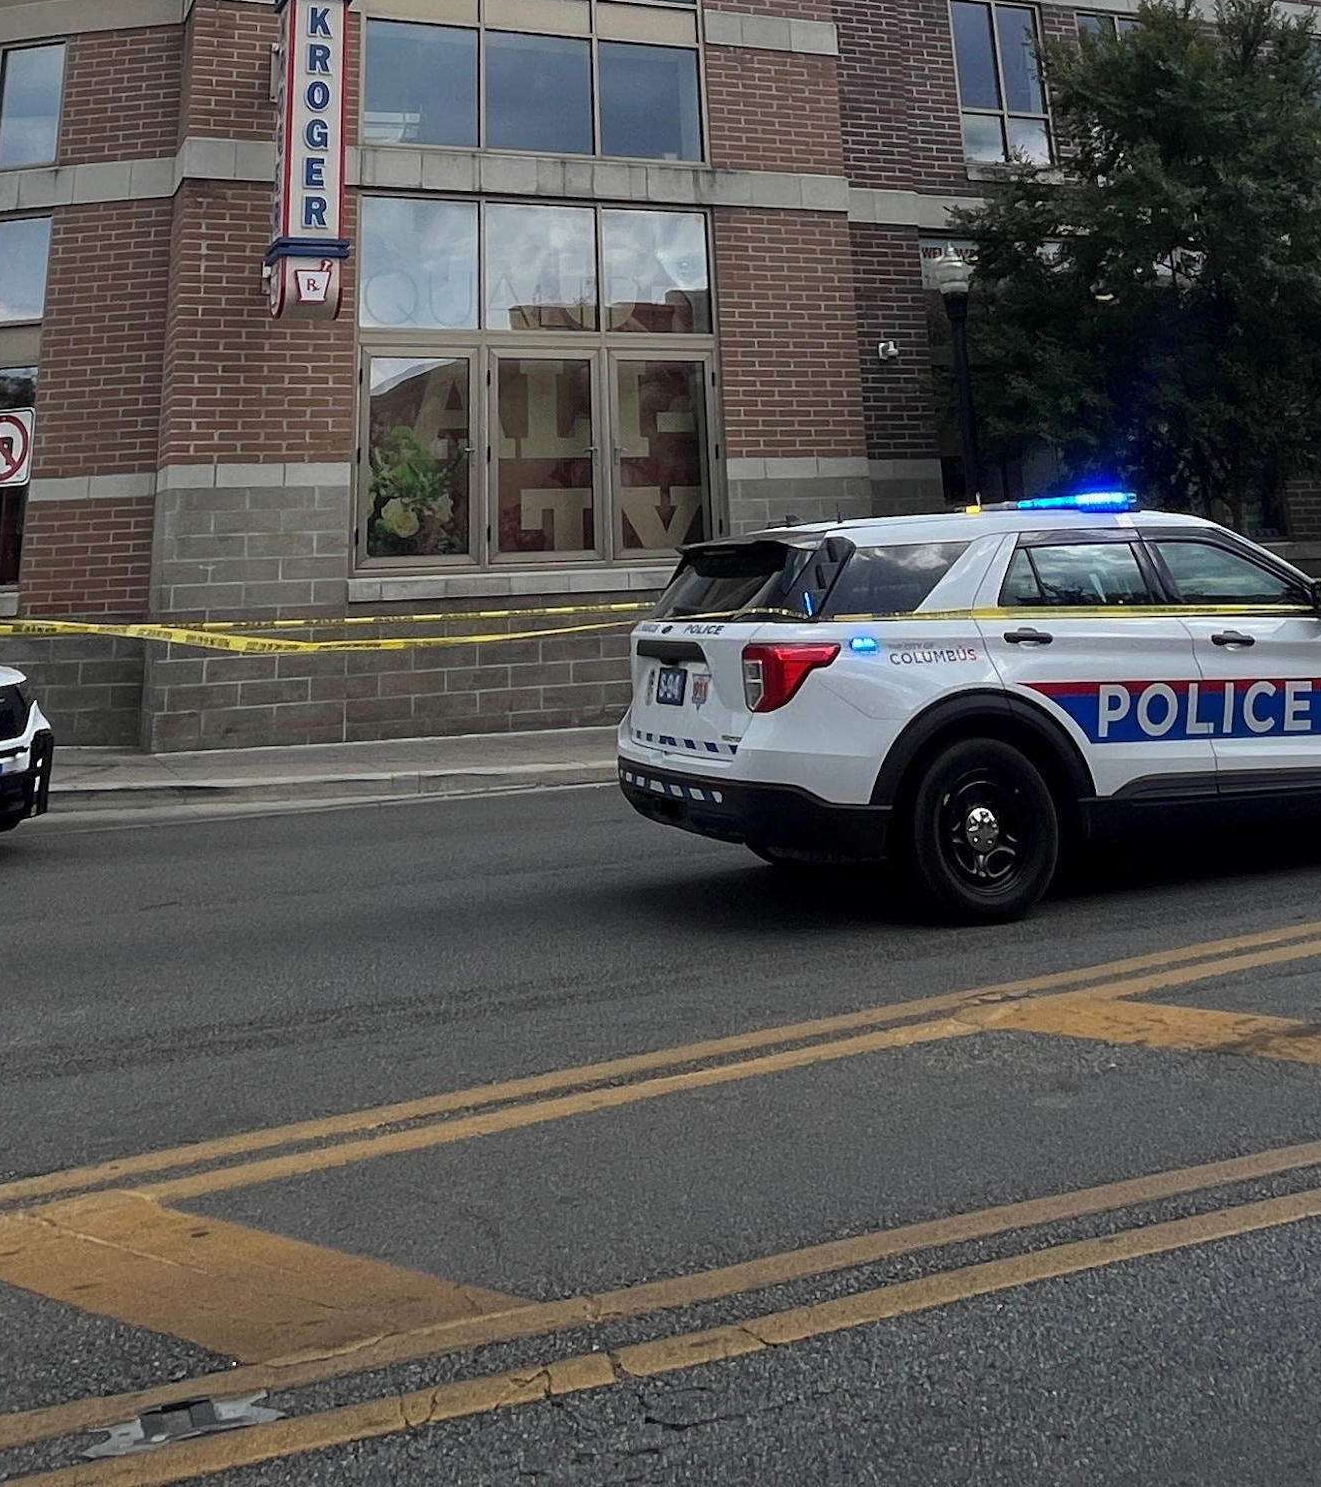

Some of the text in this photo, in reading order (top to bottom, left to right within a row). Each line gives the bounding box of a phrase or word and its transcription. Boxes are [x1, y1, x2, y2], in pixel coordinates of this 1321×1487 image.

[303, 5, 333, 229] KROGER
[684, 624, 725, 635] POLICE
[889, 647, 977, 665] COLUMBUS
[1098, 680, 1313, 737] POLICE
